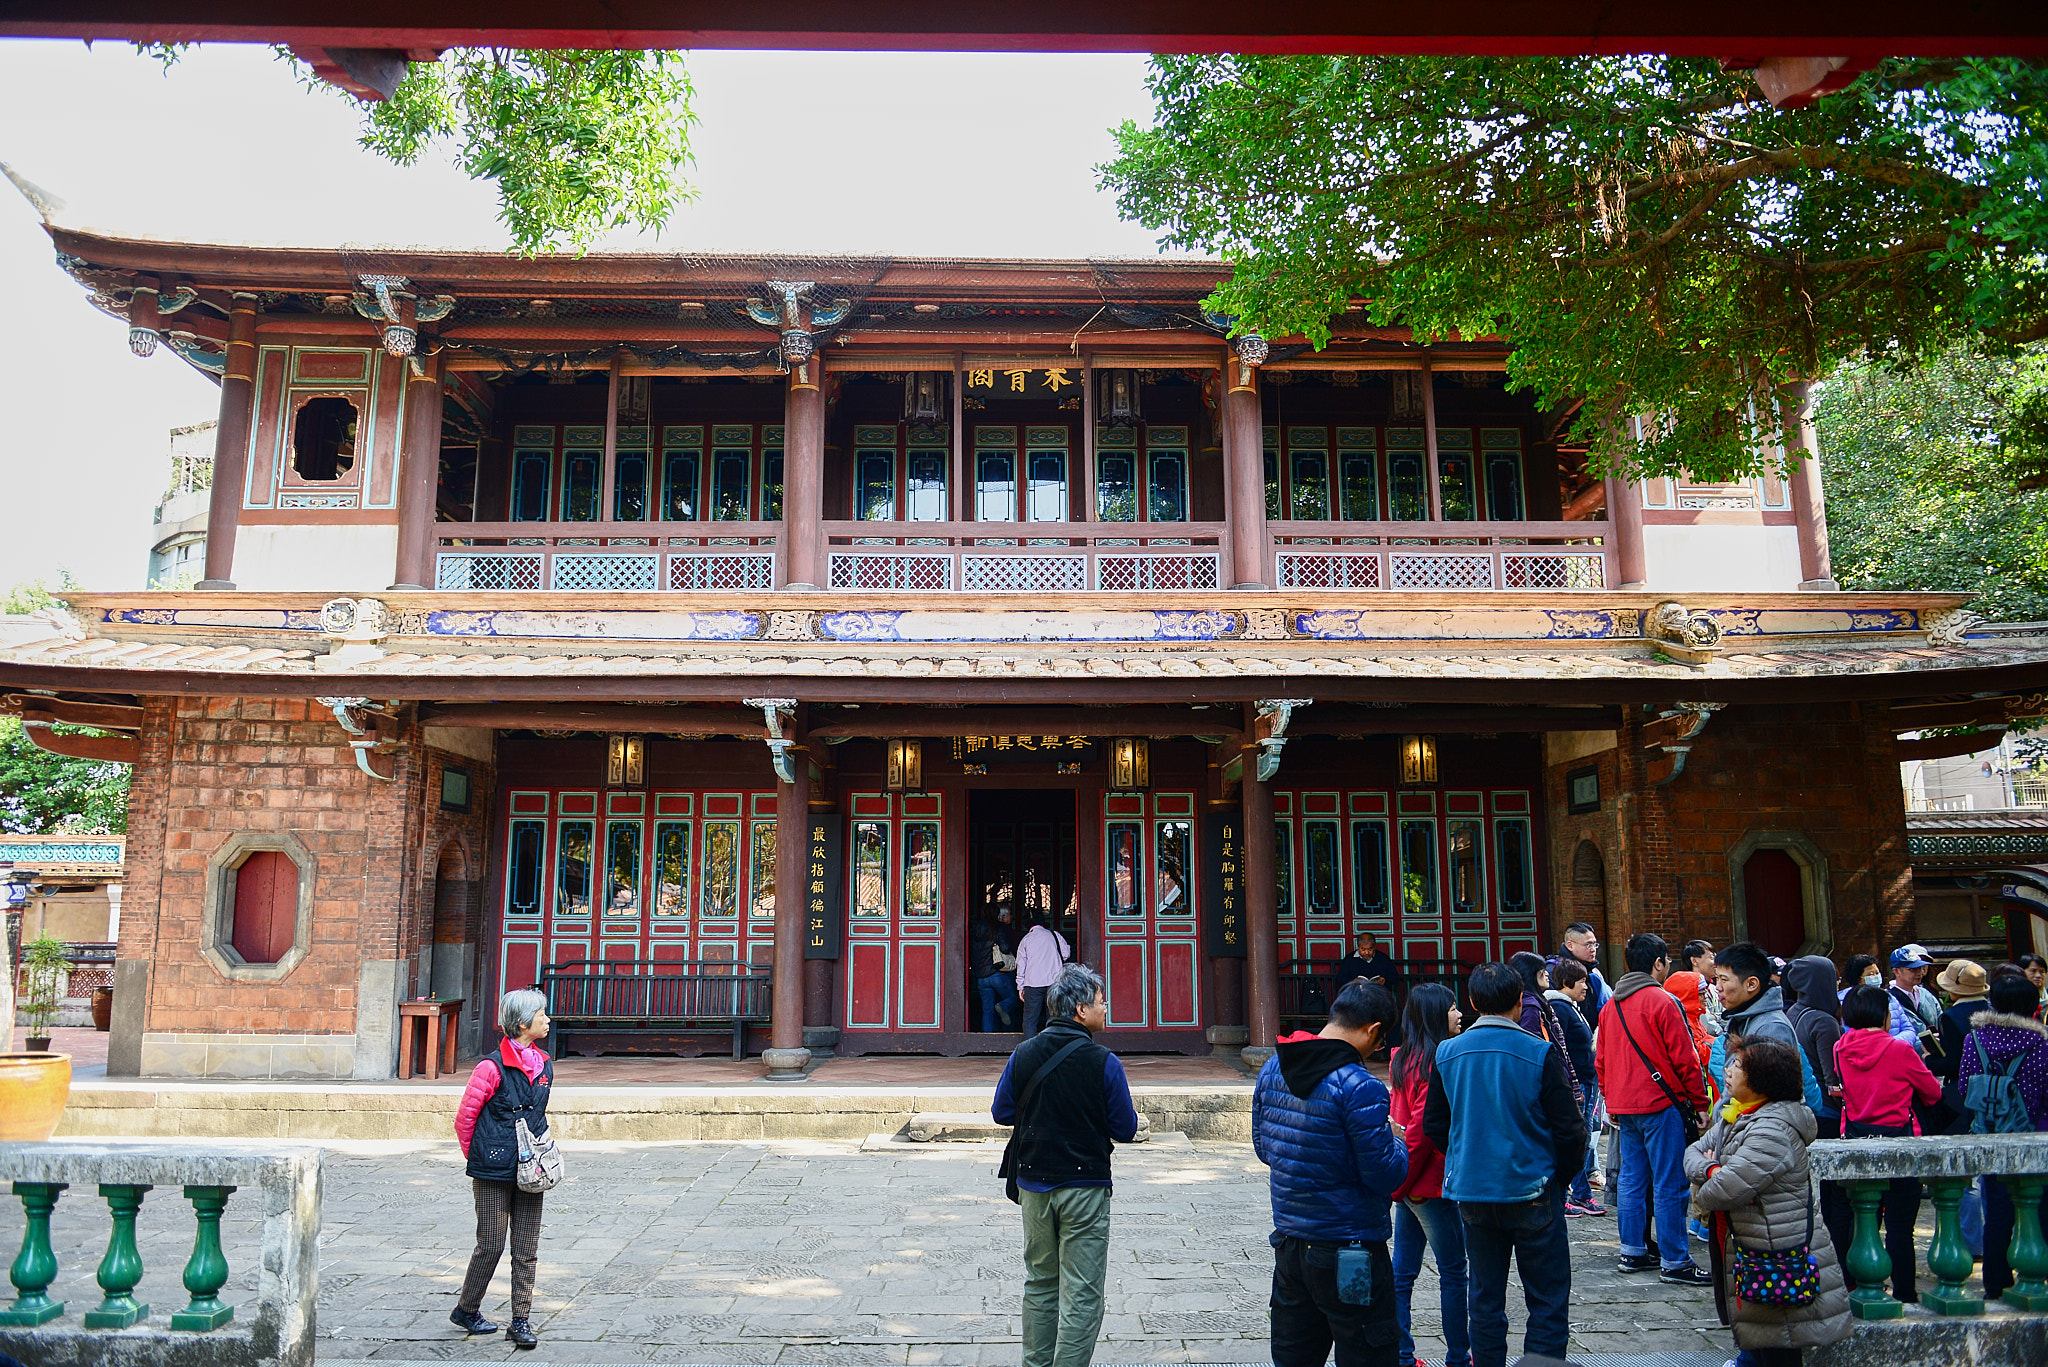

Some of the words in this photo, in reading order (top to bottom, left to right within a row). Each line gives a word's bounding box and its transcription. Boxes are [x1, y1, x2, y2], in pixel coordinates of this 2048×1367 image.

[1221, 824, 1237, 945] 自是胸羅有邱壑
